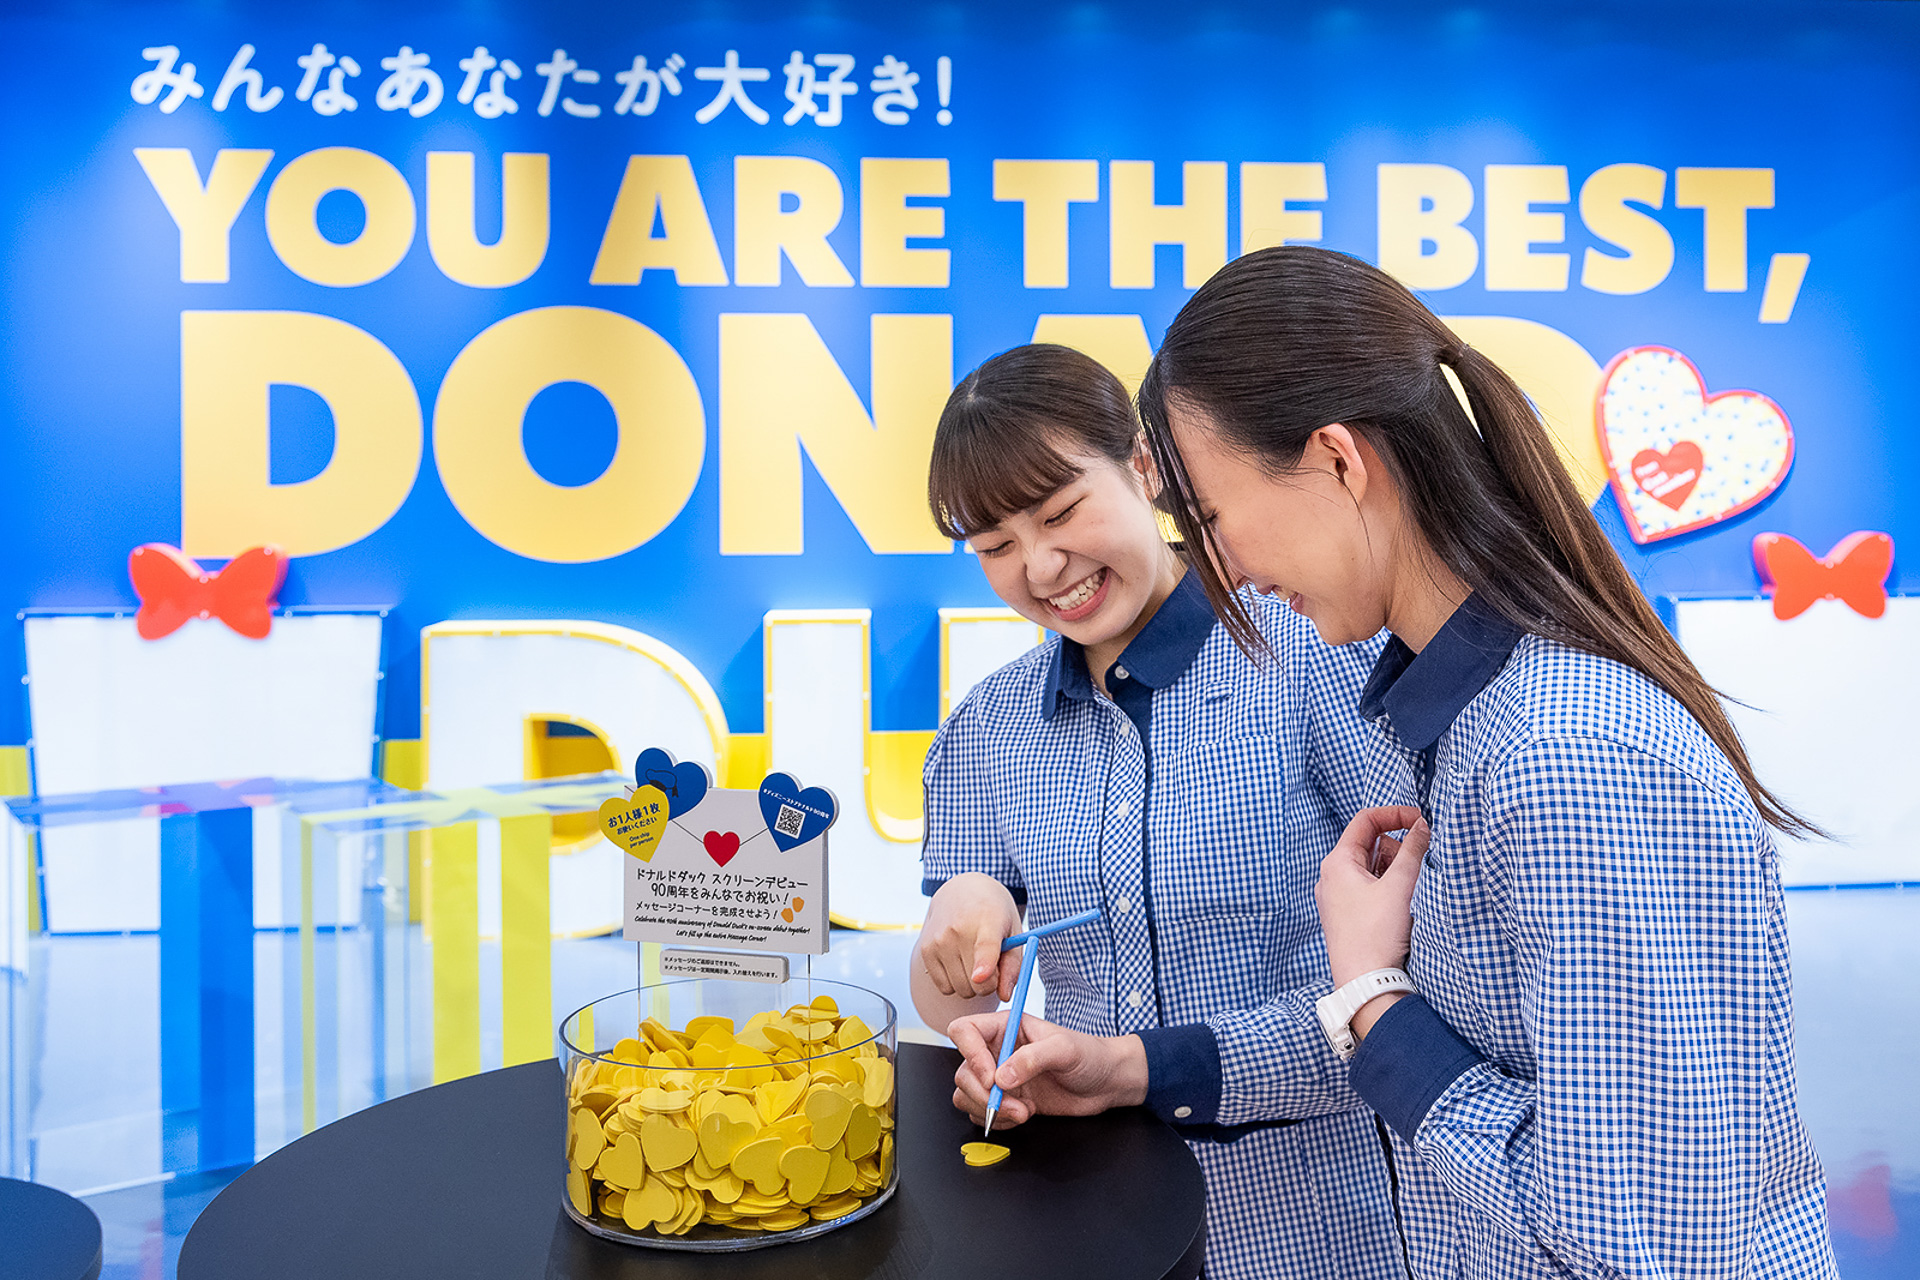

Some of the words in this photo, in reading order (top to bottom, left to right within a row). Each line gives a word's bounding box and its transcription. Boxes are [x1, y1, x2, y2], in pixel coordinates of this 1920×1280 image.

[133, 146, 551, 288] YOU
[589, 153, 952, 288] ARE
[993, 158, 1329, 290] THE
[1377, 162, 1812, 324] BEST,
[636, 868, 706, 883] ドナルドダック
[712, 873, 808, 889] スクリーンデビュー
